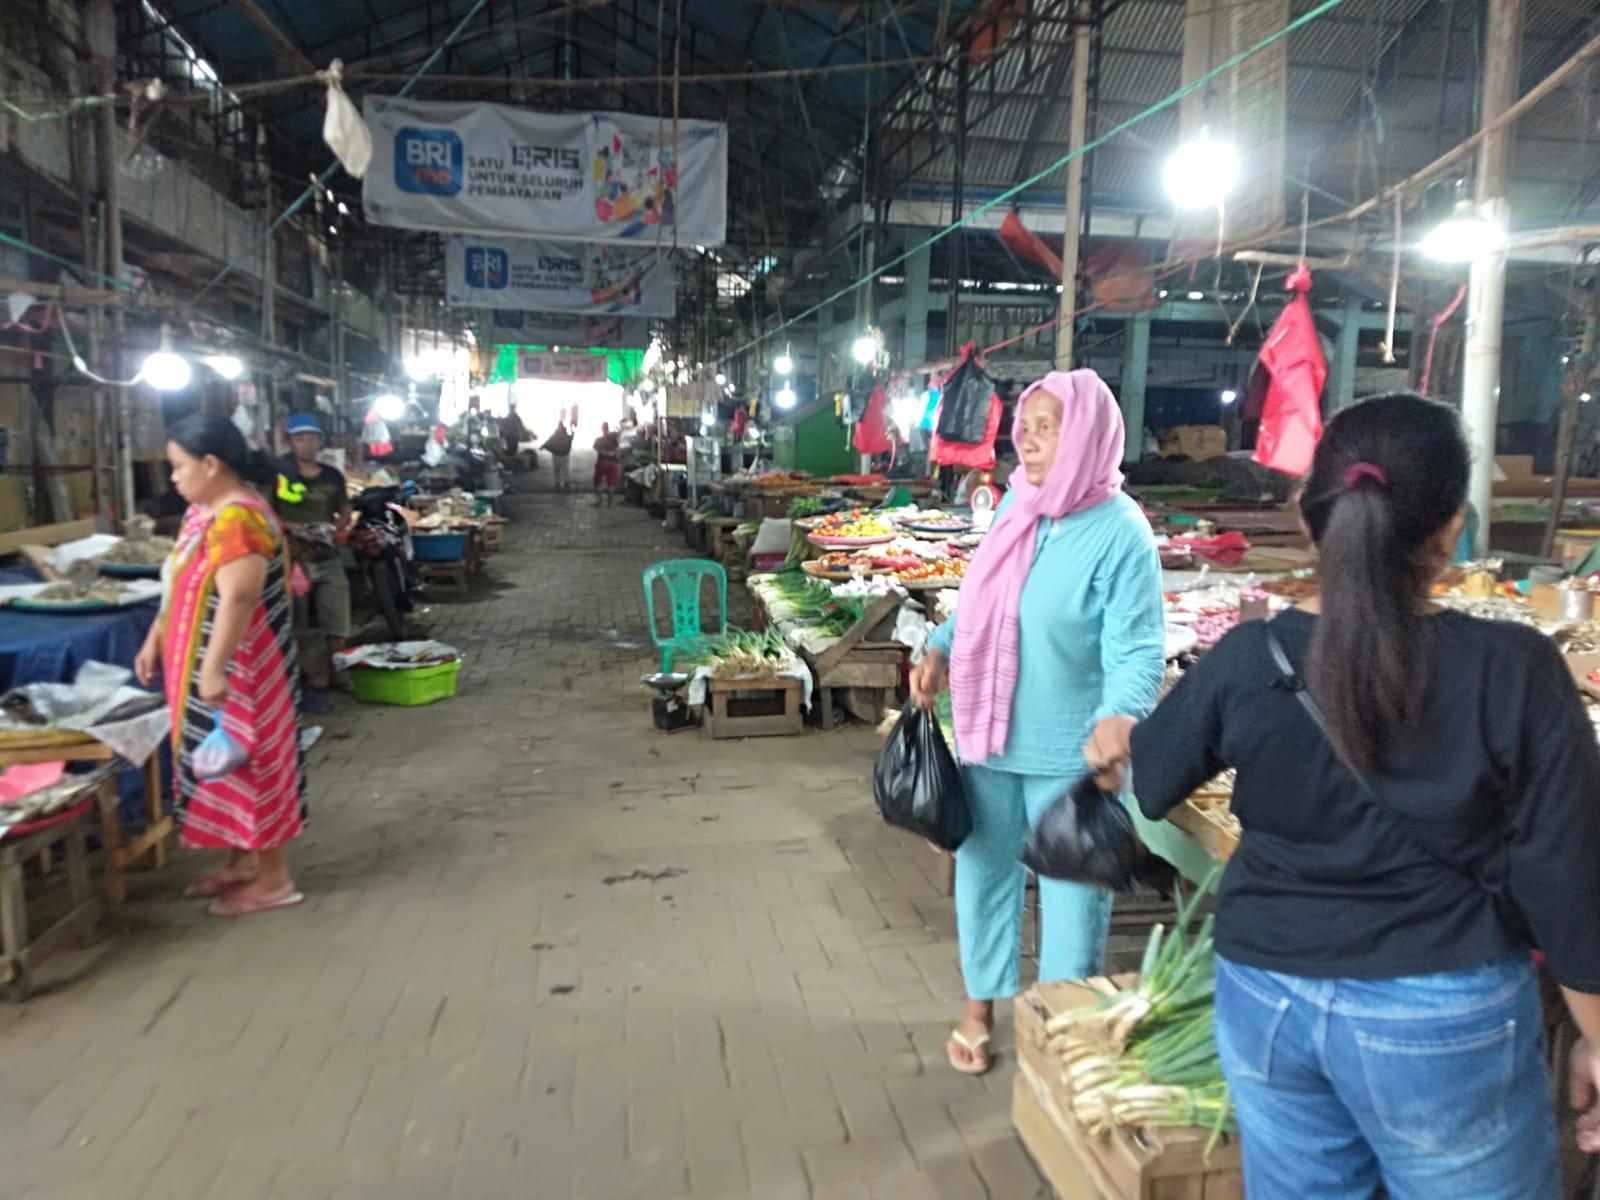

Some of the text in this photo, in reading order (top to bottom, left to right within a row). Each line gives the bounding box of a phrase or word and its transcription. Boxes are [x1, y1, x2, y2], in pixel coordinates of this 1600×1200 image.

[405, 138, 452, 167] BRI
[468, 156, 504, 170] SATU
[468, 170, 583, 190] UNTUK SELURUH
[468, 183, 562, 200] PEMBAYARAN
[471, 254, 502, 272] BRI
